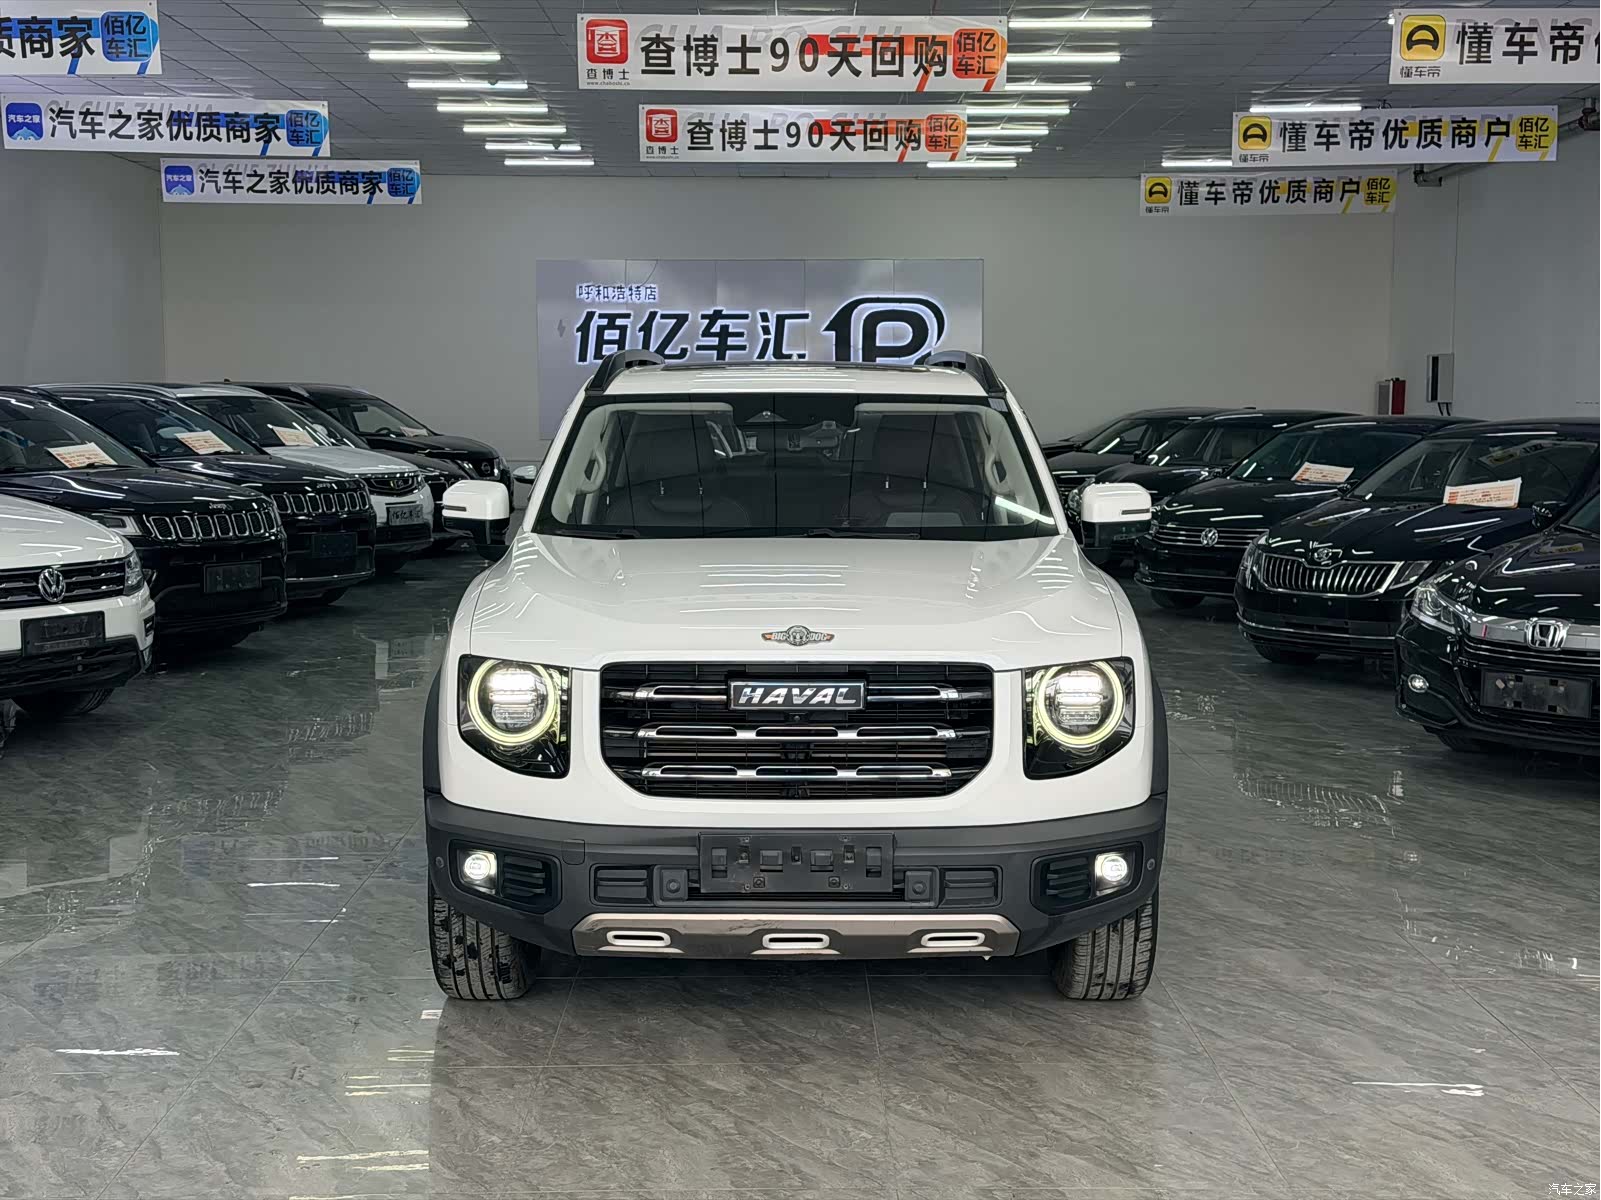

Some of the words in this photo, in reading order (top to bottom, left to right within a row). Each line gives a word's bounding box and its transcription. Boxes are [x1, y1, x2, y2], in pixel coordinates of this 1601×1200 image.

[104, 15, 146, 36] 佰亿
[106, 37, 149, 58] 车汇
[956, 32, 997, 53] 佰亿
[1455, 22, 1600, 65] 懂车帝
[640, 33, 948, 77] 查博士90天回购
[955, 54, 997, 75] 车汇
[1400, 65, 1442, 78] 懂车帝
[586, 68, 630, 80] 查博士
[7, 114, 41, 124] 汽车之家
[49, 107, 282, 144] 汽车之家优质商家
[289, 112, 320, 128] 佰亿
[928, 116, 960, 133] 佰亿
[1518, 117, 1550, 133] 佰亿
[289, 129, 321, 144] 车汇
[686, 119, 922, 151] 查博士90天回购
[928, 133, 960, 150] 车汇
[1279, 117, 1511, 152] 懂车帝优质商户
[1518, 134, 1550, 150] 车汇
[199, 168, 385, 196] 汽车之家优质商家
[1366, 177, 1391, 190] 佰亿
[1177, 178, 1361, 206] 懂车帝优质商户
[1366, 191, 1391, 204] 车汇
[578, 285, 657, 301] 呼和浩特店
[575, 309, 810, 363] 佰亿车汇
[771, 632, 787, 641] BIG
[809, 632, 827, 641] DOG
[738, 688, 857, 705] HAVAL
